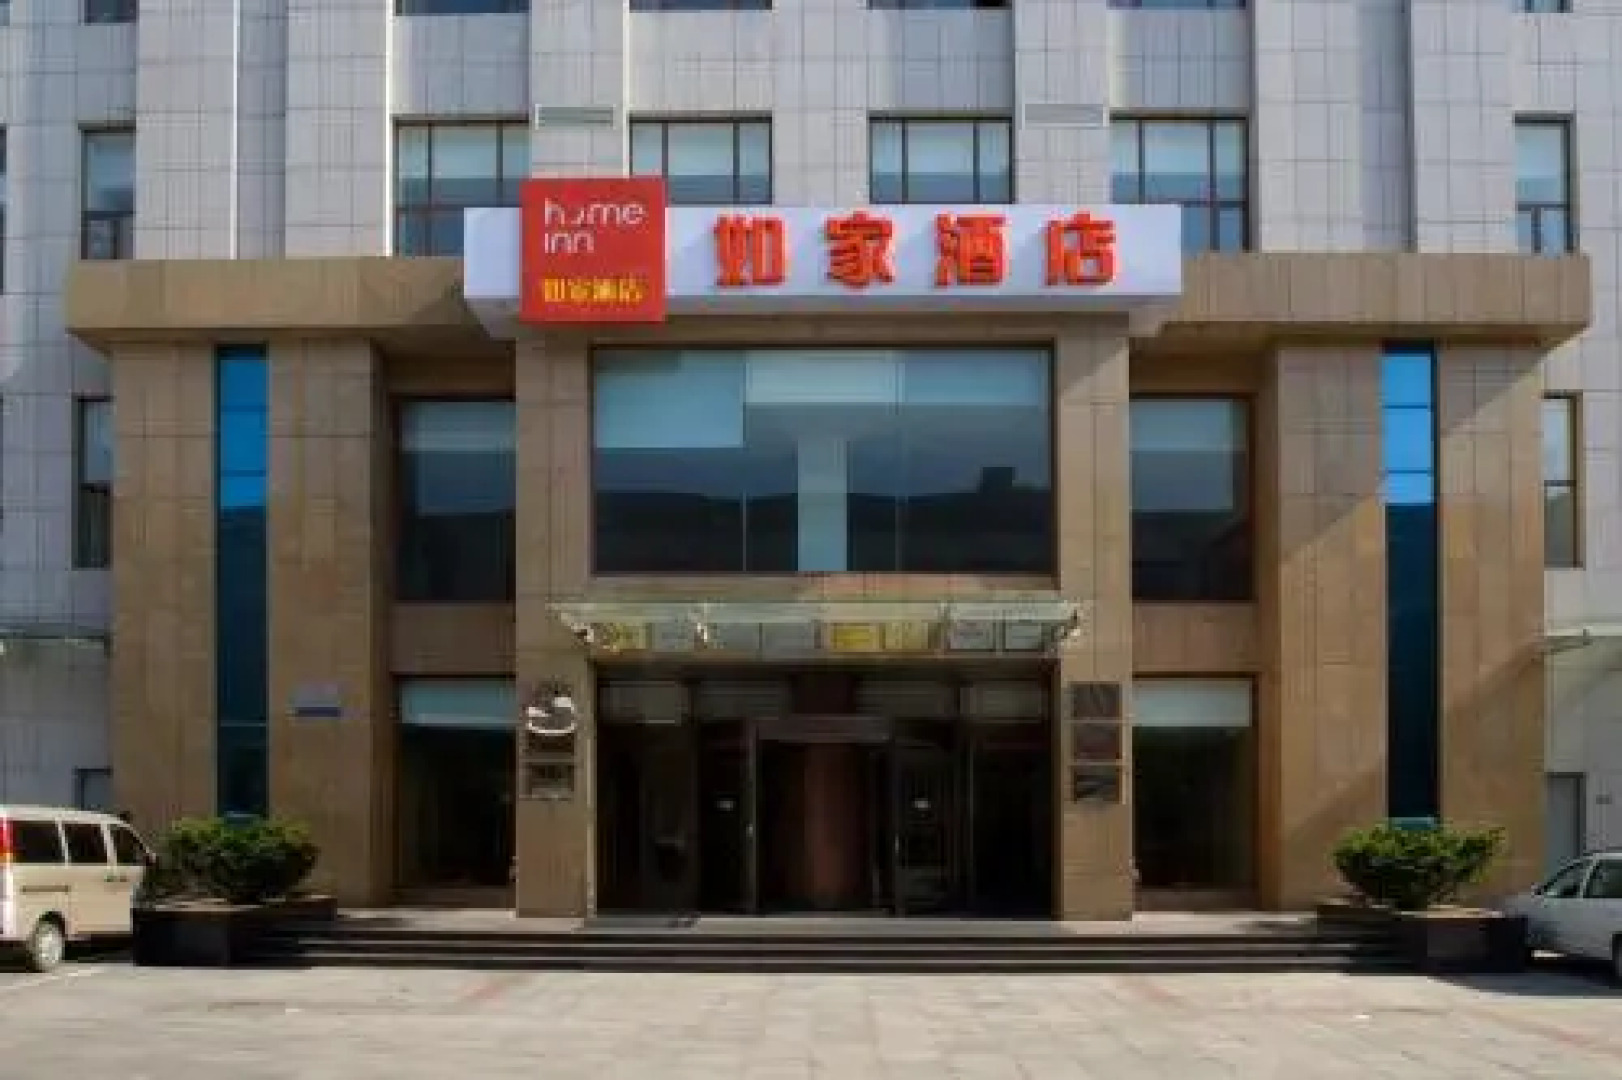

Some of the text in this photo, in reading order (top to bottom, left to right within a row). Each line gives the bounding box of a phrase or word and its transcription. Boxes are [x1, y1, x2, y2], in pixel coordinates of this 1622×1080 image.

[545, 232, 595, 254] inn
[713, 211, 1117, 287] 如家酒店
